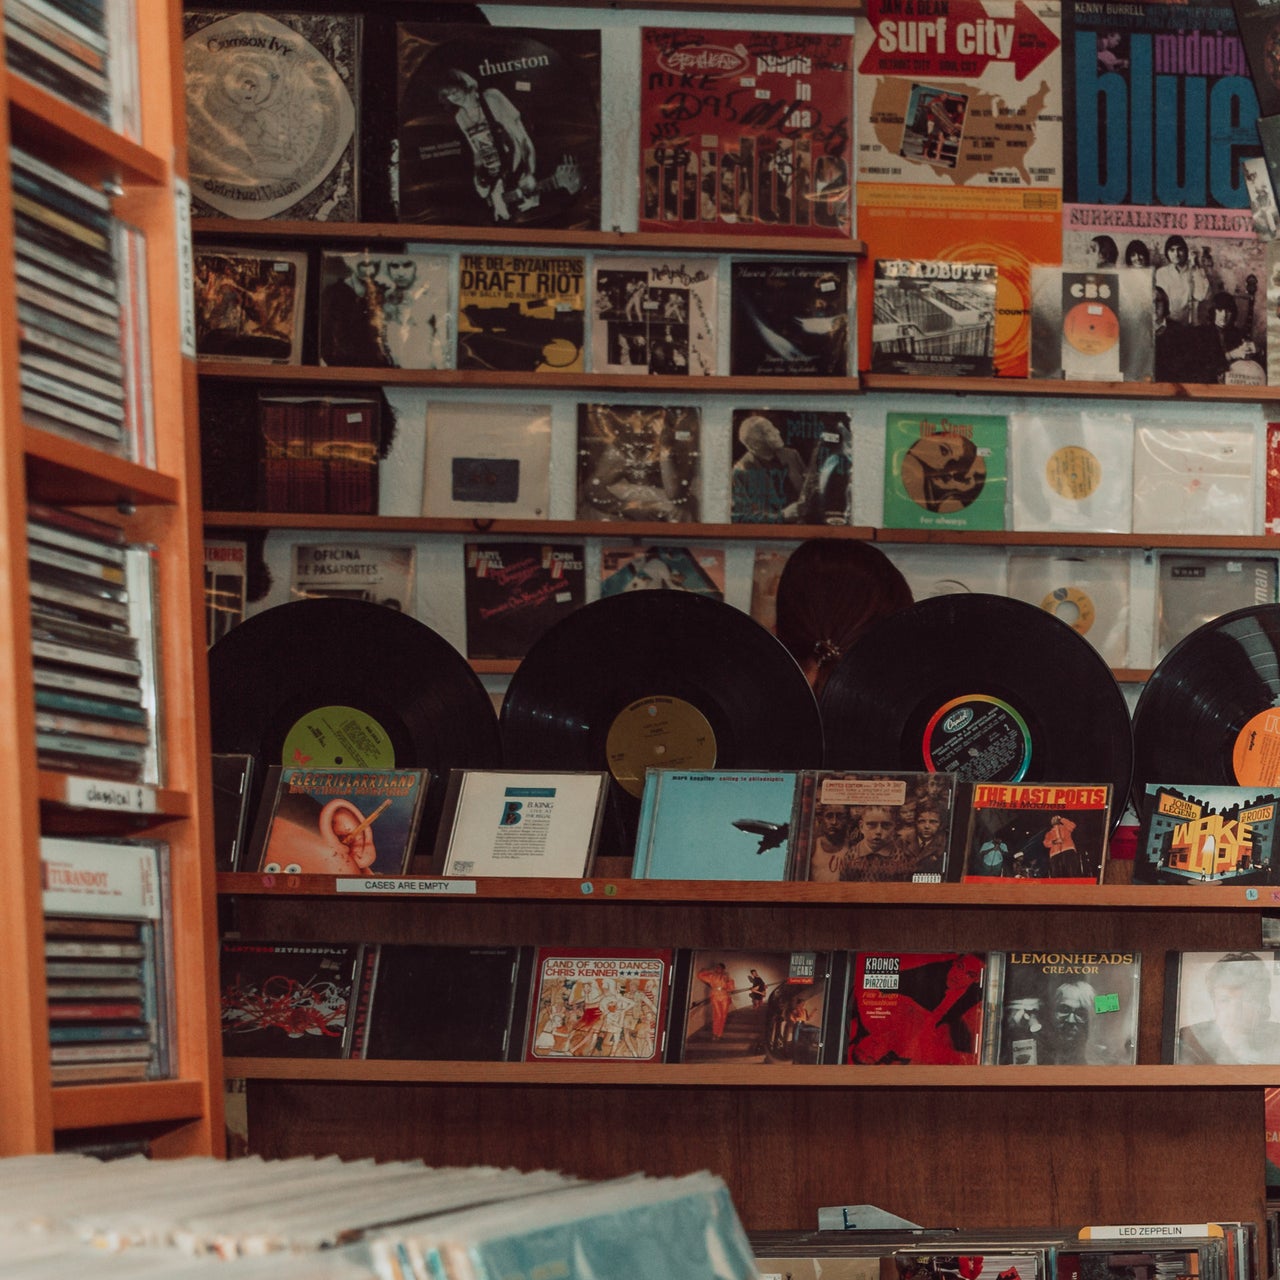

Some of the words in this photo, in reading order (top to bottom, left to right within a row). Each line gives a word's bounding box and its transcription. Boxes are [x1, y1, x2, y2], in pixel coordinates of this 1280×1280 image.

[1074, 1, 1105, 14] KENNY
[1107, 3, 1144, 16] BURRELL
[878, 17, 947, 54] surf
[956, 19, 1016, 59] city
[478, 52, 550, 77] thurston
[796, 80, 811, 101] in
[1075, 31, 1263, 209] blue
[1070, 208, 1188, 230] SURREALISTIC
[463, 256, 484, 270] THE
[486, 257, 584, 274] DEL-BYZANTEENS
[461, 270, 531, 292] DRAFT
[537, 273, 584, 294] RIOT
[1069, 282, 1111, 299] CBS
[940, 418, 974, 440] Stems
[313, 549, 361, 562] OFICINA
[313, 564, 379, 577] PASAPORTES
[978, 786, 1009, 803] THE
[1010, 786, 1052, 804] LAST
[1056, 787, 1105, 806] POETS
[1019, 799, 1067, 810] Madness
[1163, 804, 1198, 820] LEGEND
[1170, 799, 1193, 811] JOHN
[1246, 806, 1273, 823] ROOTS
[1172, 813, 1254, 848] WAKE
[1190, 840, 1240, 875] UP!
[50, 868, 109, 889] TURANDOT
[364, 880, 396, 891] CASES
[397, 881, 417, 891] ARE
[418, 881, 450, 892] EMPTY
[546, 960, 573, 970] LAND
[575, 960, 589, 970] OF
[590, 960, 616, 971] 1000
[618, 961, 660, 972] DANCES
[865, 957, 900, 972] KRONOS
[1010, 953, 1134, 966] LEMONHEADS
[545, 968, 574, 978] CHRIS
[577, 968, 618, 978] KENNER
[1042, 965, 1099, 975] CREATOR
[864, 978, 900, 990] PIAZZOLLA
[842, 1208, 857, 1230] L
[1118, 1226, 1138, 1236] LED
[1138, 1226, 1183, 1236] ZEPPELIN
